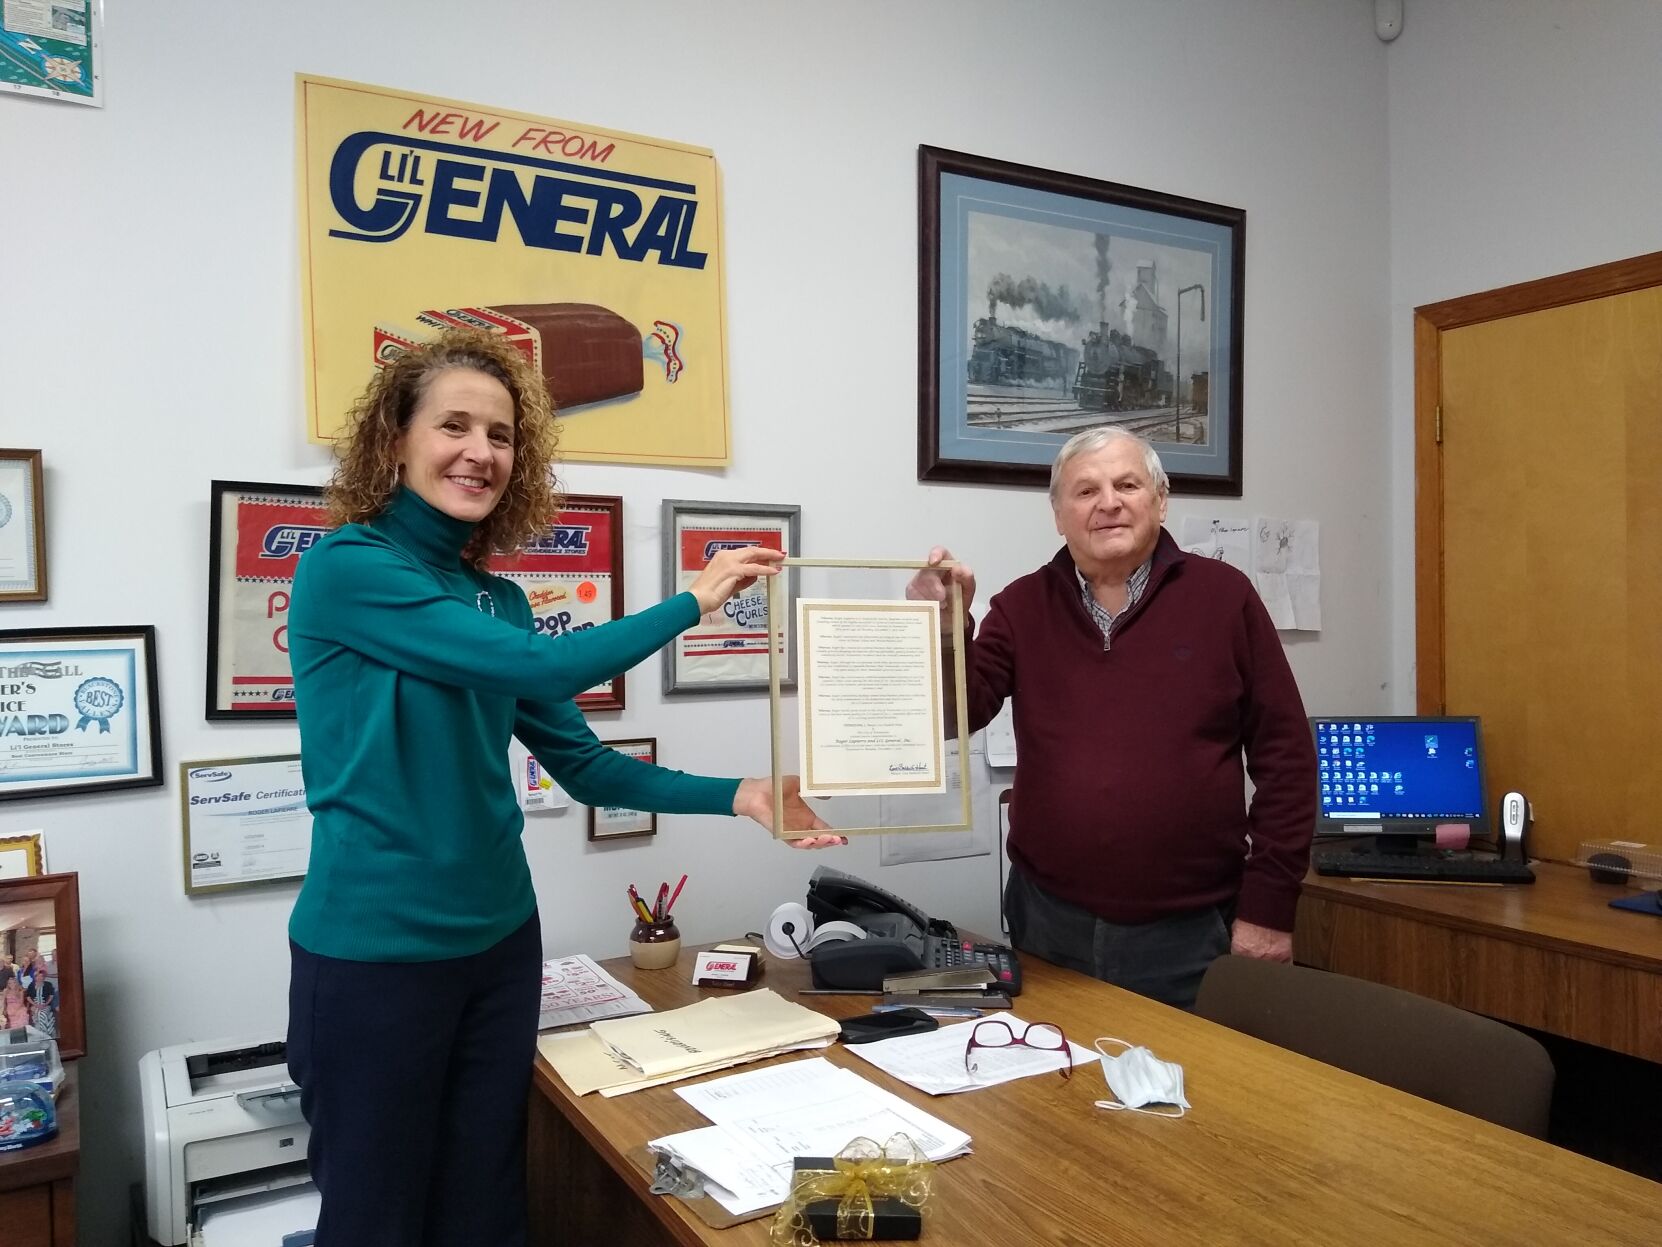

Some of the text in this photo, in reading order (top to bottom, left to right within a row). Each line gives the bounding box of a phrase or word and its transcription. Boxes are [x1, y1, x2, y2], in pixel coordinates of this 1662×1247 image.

[402, 108, 616, 163] NEW FROM
[379, 149, 425, 186] LI'L
[328, 131, 708, 270] GENERAL
[724, 596, 762, 618] CHEESE
[736, 606, 768, 626] CURLS
[0, 681, 36, 696] ER'S
[0, 701, 27, 712] ICE
[86, 690, 112, 707] BEST
[194, 770, 229, 778] ServSafe
[190, 792, 251, 805] ServSafe
